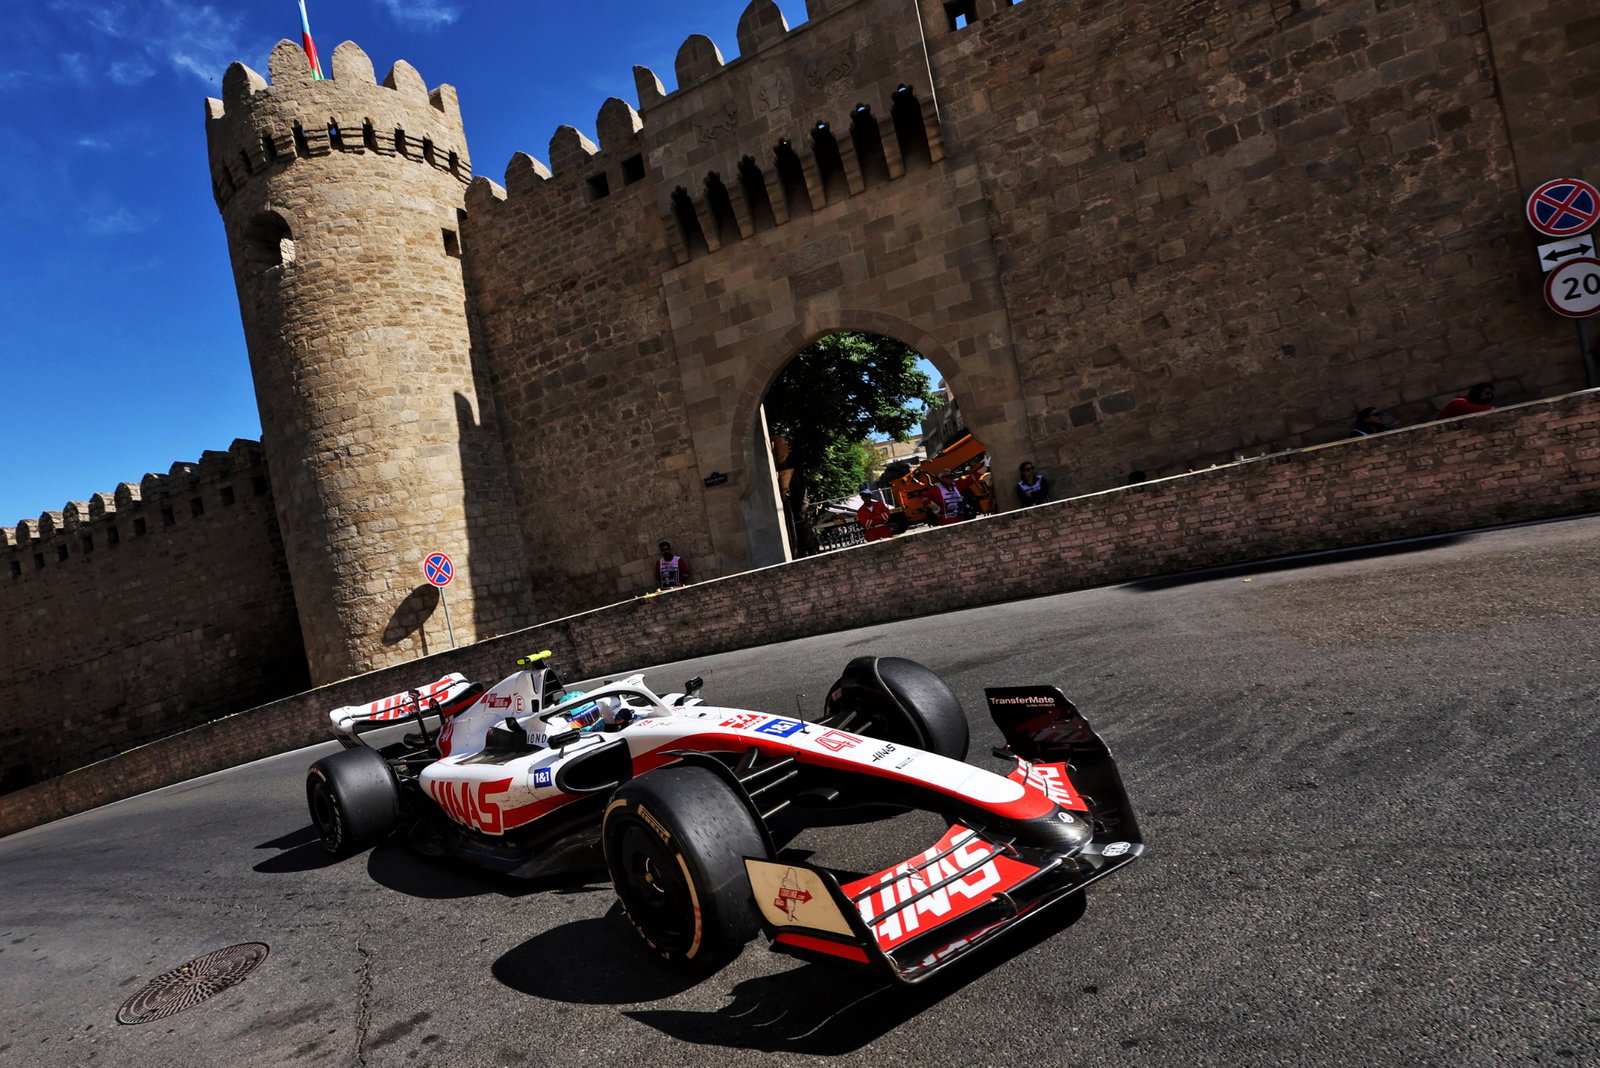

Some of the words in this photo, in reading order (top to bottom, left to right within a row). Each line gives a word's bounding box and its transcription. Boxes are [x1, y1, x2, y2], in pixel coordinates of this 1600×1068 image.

[1562, 273, 1600, 300] 20
[990, 696, 1055, 705] TransferMate
[769, 719, 798, 735] 1&1
[814, 730, 864, 752] 47
[535, 771, 550, 784] 1&1
[430, 777, 513, 834] HAAS
[856, 829, 1001, 943] HAAS
